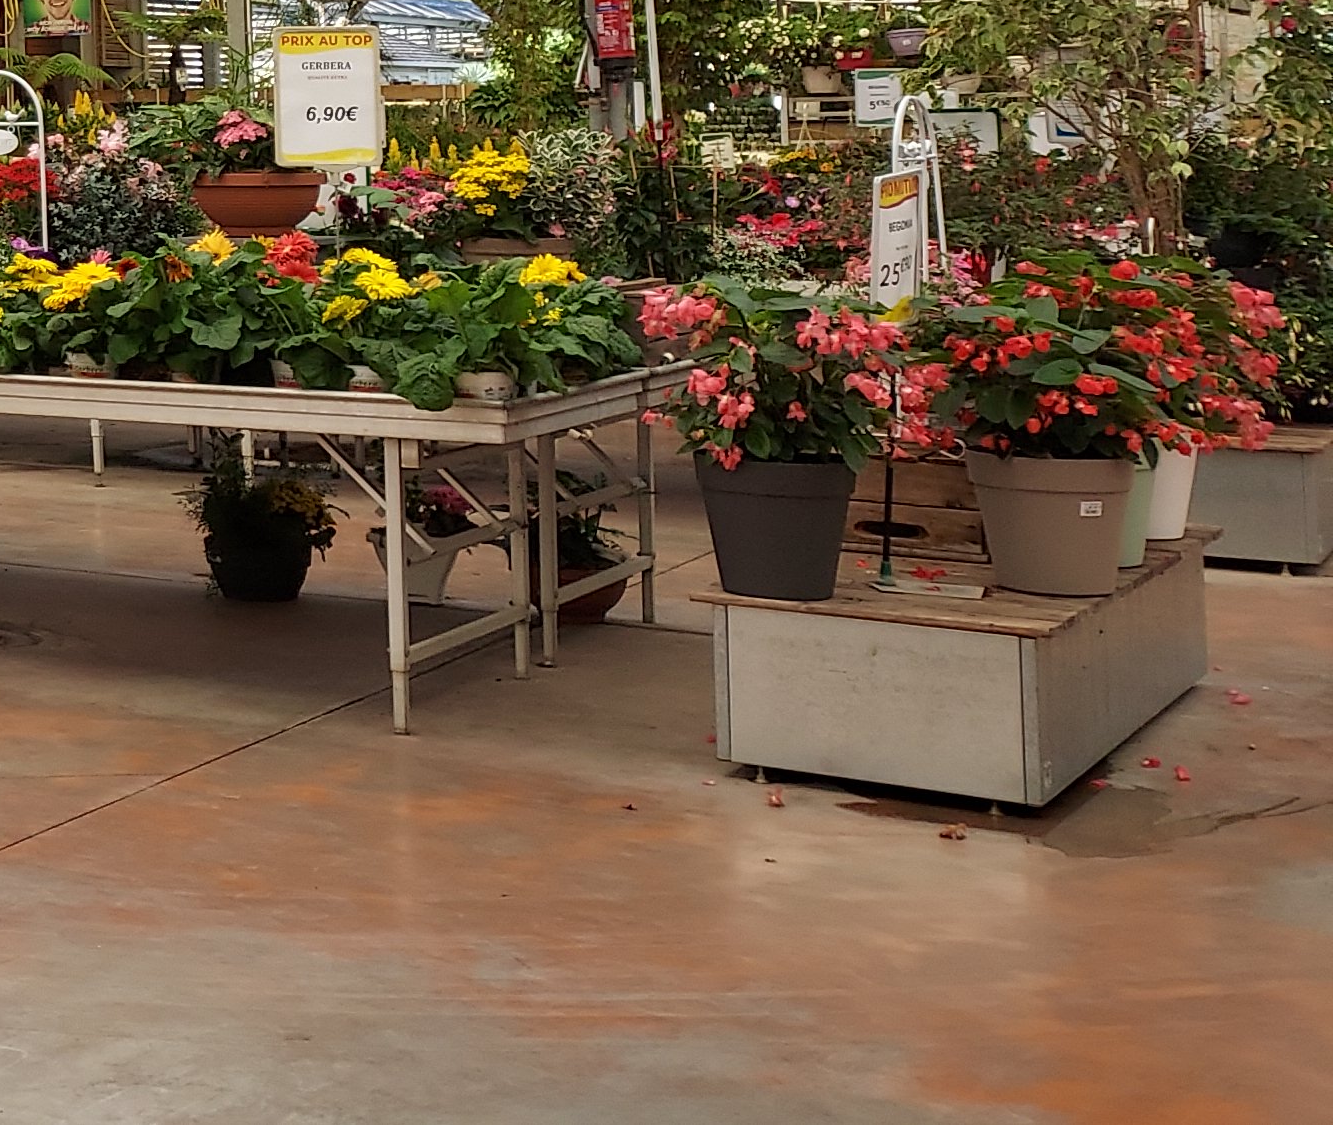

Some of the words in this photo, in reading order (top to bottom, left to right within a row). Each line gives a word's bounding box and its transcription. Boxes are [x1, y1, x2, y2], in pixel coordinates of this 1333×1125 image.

[281, 35, 314, 46] PRIX
[318, 35, 338, 46] AU
[343, 35, 373, 46] TOP
[301, 61, 352, 71] GERBERA
[306, 106, 359, 125] 6,90€
